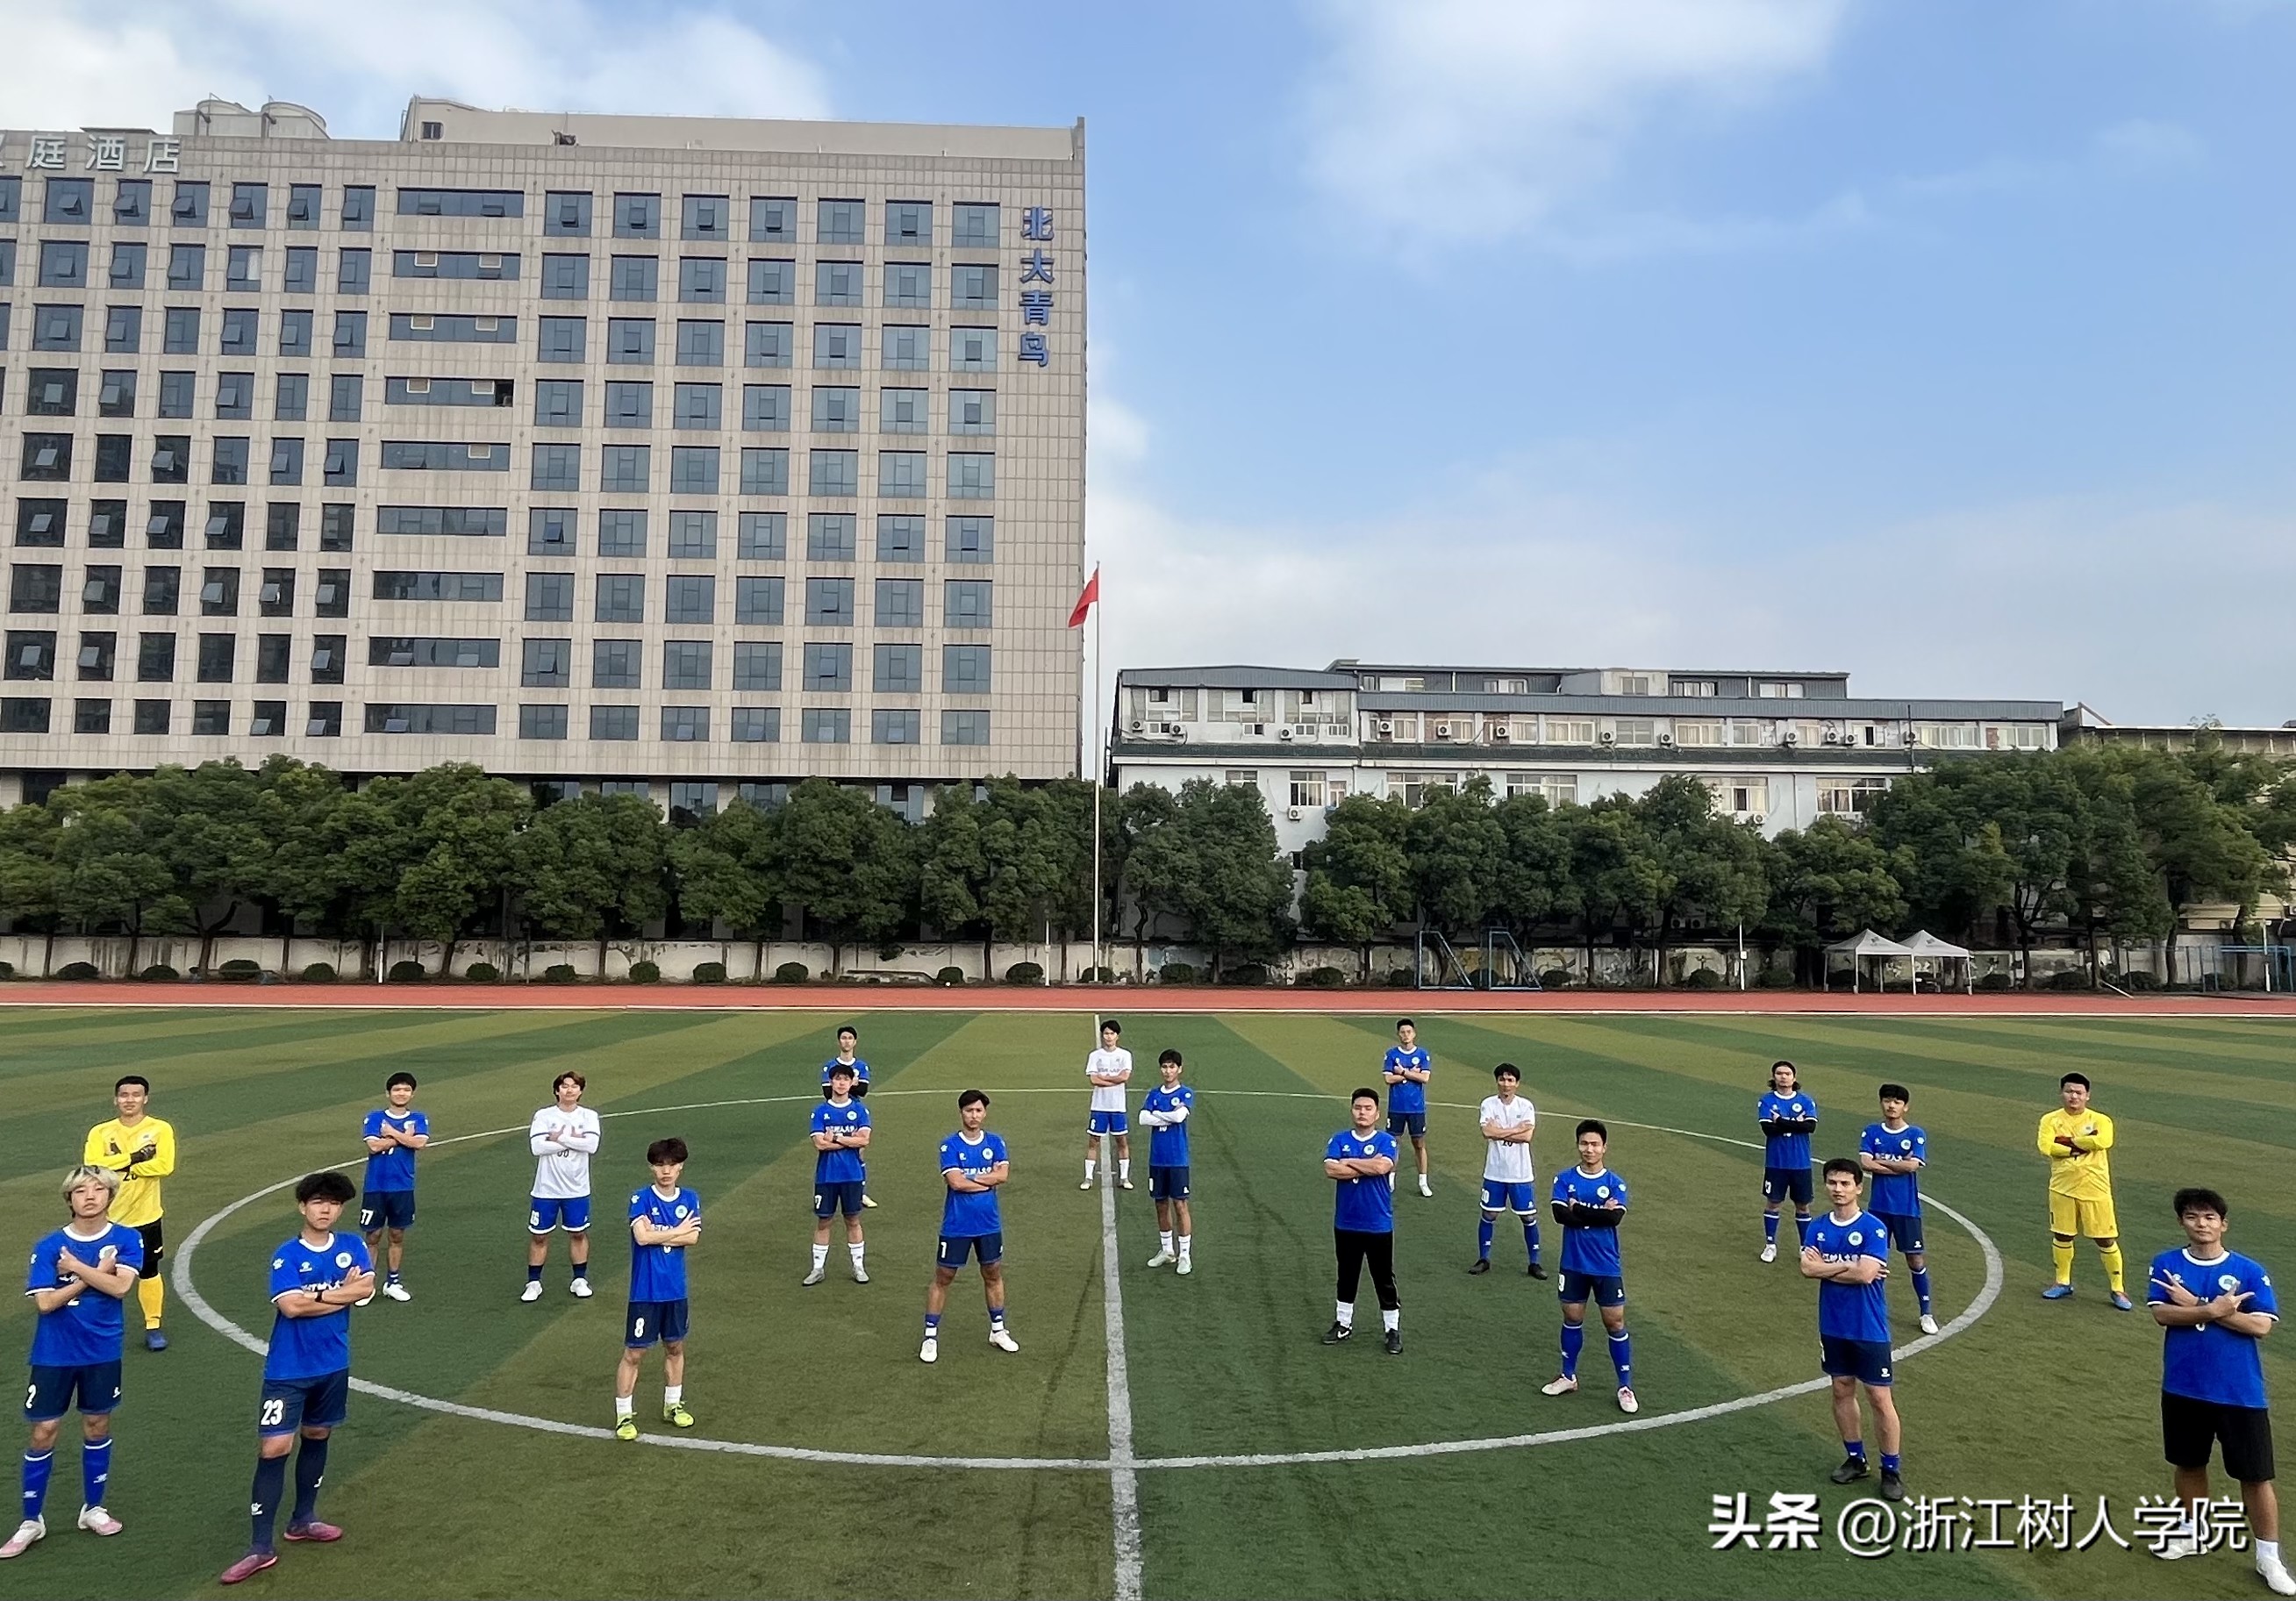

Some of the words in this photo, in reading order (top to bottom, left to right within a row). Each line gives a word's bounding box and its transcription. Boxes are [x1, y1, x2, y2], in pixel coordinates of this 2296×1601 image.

[0, 133, 181, 175] 庭酒店
[1018, 206, 1055, 367] 北大青鸟
[634, 1317, 645, 1338] 8
[25, 1383, 37, 1409] 2
[261, 1399, 284, 1426] 23
